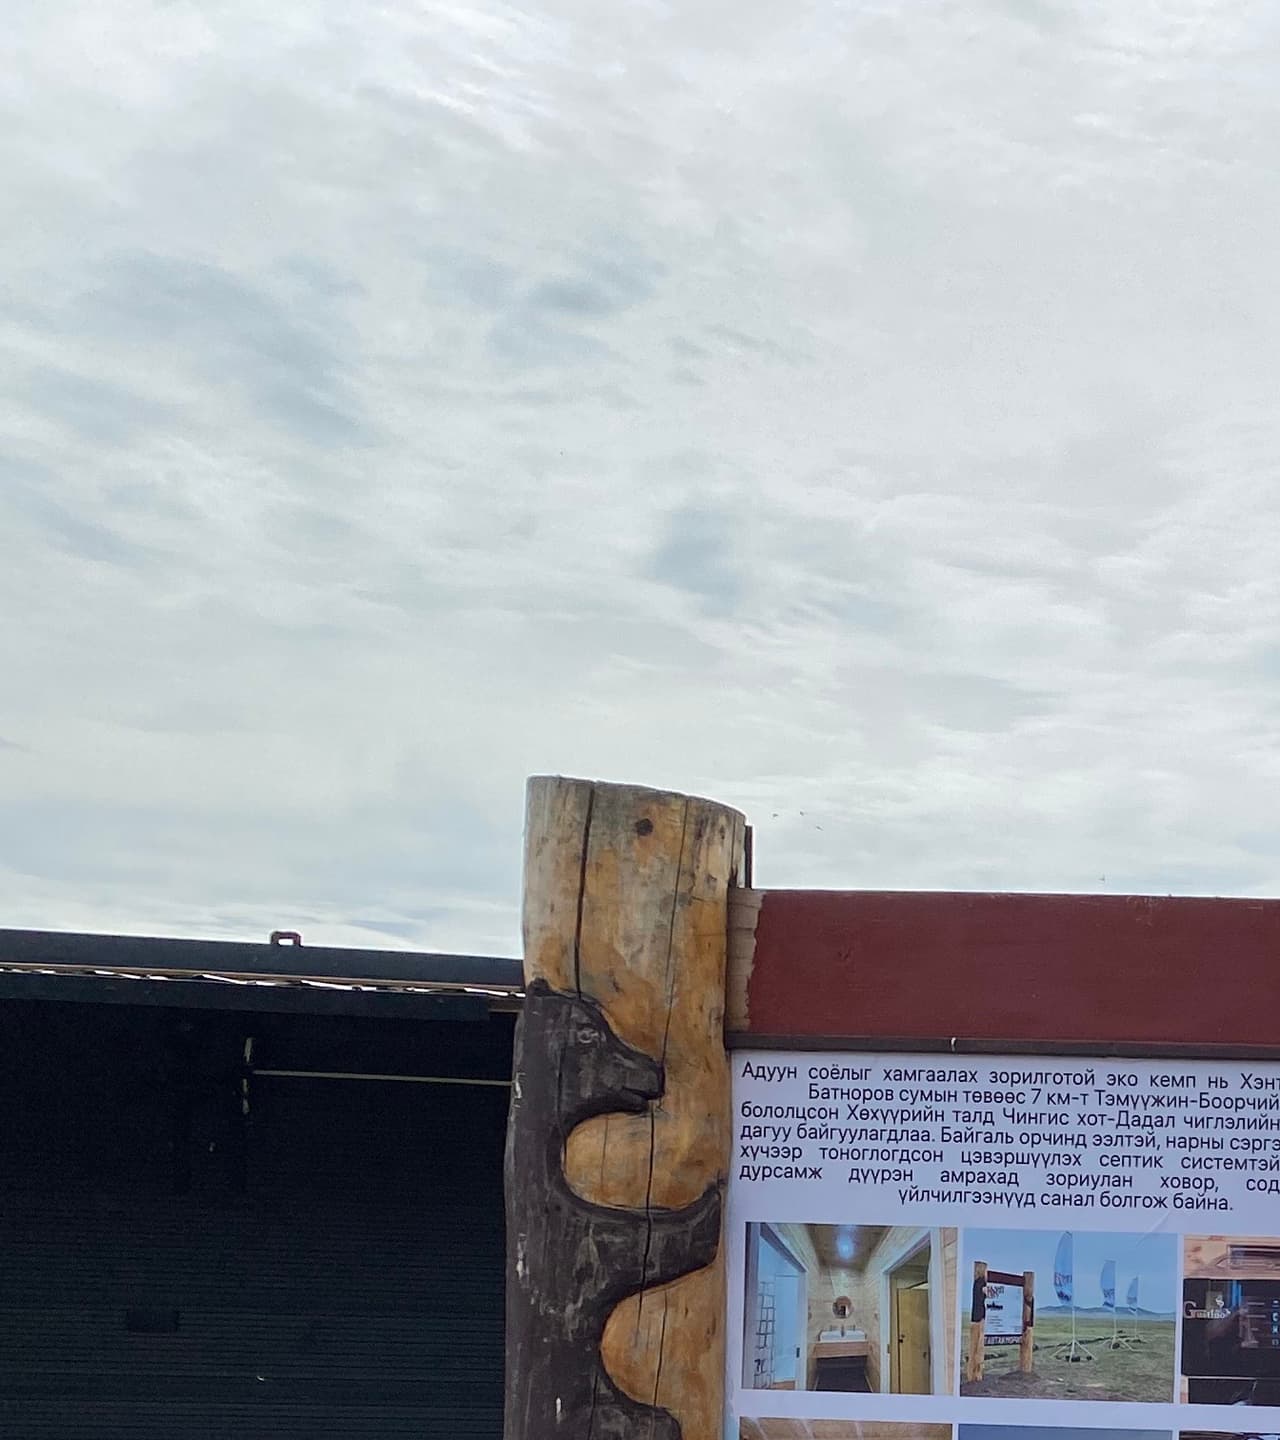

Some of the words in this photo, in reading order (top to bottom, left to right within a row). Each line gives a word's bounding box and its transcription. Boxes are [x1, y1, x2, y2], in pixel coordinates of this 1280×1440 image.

[741, 1061, 797, 1082] Адуун
[808, 1064, 872, 1081] соёлыг
[883, 1069, 978, 1083] хамгаалах
[989, 1068, 1095, 1088] зорилготой
[1106, 1073, 1138, 1087] эко
[1150, 1074, 1196, 1088] кемп
[1208, 1076, 1229, 1089] нь
[809, 1083, 894, 1105] Батноров
[899, 1089, 958, 1106] сумын
[962, 1090, 1026, 1104] төвөөс
[1031, 1088, 1042, 1104] 7
[741, 1100, 839, 1122] бололцсон
[846, 1103, 945, 1125] Хөхүүрийн
[952, 1110, 995, 1127] талд
[1003, 1107, 1069, 1126] Чингис
[1183, 1113, 1280, 1131] чиглэлийн
[740, 1125, 792, 1143] дагуу
[797, 1122, 935, 1145] байгуулагдлаа.
[941, 1126, 1014, 1144] Байгаль
[1019, 1132, 1087, 1149] орчинд
[1092, 1130, 1160, 1151] ээлтэй,
[1166, 1136, 1224, 1153] нарны
[740, 1145, 803, 1163] хүчээр
[818, 1147, 943, 1165] тоноглогдсон
[961, 1151, 1082, 1169] цэвэршүүлэх
[1099, 1154, 1164, 1168] септик
[739, 1165, 823, 1182] дурсамж
[848, 1168, 913, 1185] дүүрэн
[940, 1170, 1019, 1188] амрахад
[1046, 1173, 1133, 1191] зориулан
[1160, 1176, 1219, 1197] ховор,
[898, 1186, 1036, 1208] үйлчилгээнүүд
[1040, 1193, 1094, 1207] санал
[1100, 1190, 1168, 1209] болгож
[1173, 1192, 1233, 1211] байна.
